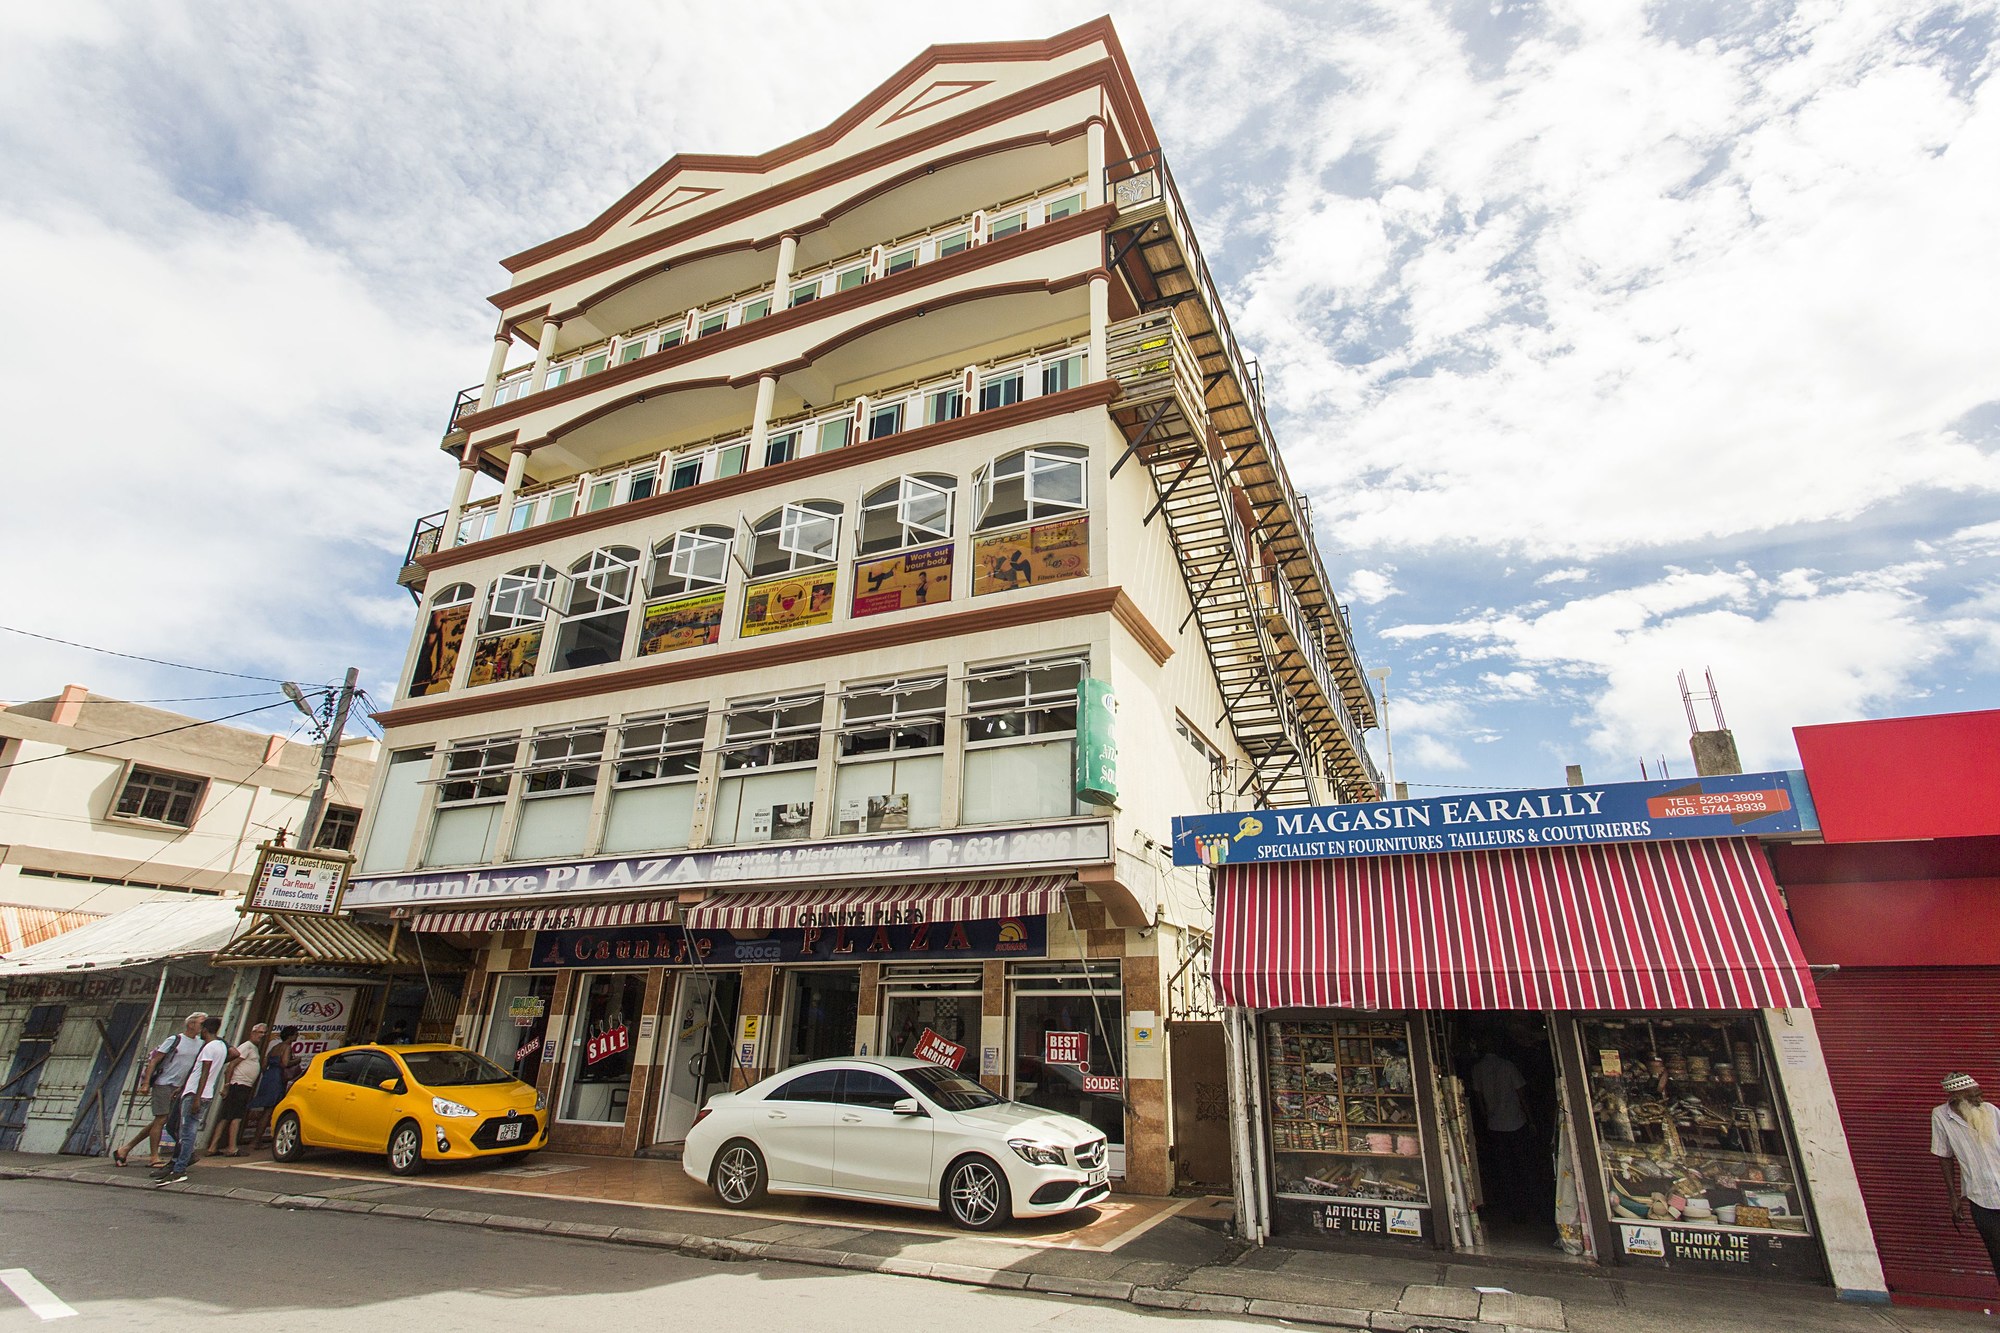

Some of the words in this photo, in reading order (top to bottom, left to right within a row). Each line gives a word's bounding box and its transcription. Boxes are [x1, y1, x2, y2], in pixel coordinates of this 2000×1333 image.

[982, 532, 1029, 547] AEROBIC
[910, 551, 932, 561] Work
[934, 548, 949, 557] out
[905, 562, 925, 571] your
[926, 557, 948, 567] body
[1667, 796, 1696, 807] TEL:
[1699, 792, 1764, 804] 5290-3909
[1275, 805, 1434, 836] MAGASIN
[1440, 791, 1605, 825] EARALLY
[1665, 805, 1699, 817] MOB:
[1701, 802, 1767, 815] 5744-8939
[963, 835, 1006, 863] 631
[1011, 831, 1071, 861] 2696
[1257, 838, 1326, 859] SPECIALIST
[1328, 839, 1346, 855] EN
[1348, 834, 1443, 855] FOURNITURES
[1447, 828, 1525, 848] TAILLEURS
[1528, 829, 1539, 843] &
[1542, 820, 1652, 843] COUTURIERES
[267, 853, 290, 864] Motel
[290, 856, 297, 865] &
[298, 857, 319, 869] Guest
[320, 861, 343, 872] House
[714, 853, 778, 868] Importer
[780, 850, 793, 863] &
[795, 845, 880, 862] Distributor
[882, 841, 903, 856] of
[780, 862, 820, 878] TILES
[840, 856, 921, 875] GRANITES
[282, 878, 294, 888] Car
[294, 880, 316, 890] Rental
[369, 873, 538, 901] Caunhye
[541, 856, 705, 891] PLAZA
[272, 887, 296, 898] Fitness
[297, 891, 319, 900] Centre
[876, 908, 924, 924] PLAZA
[574, 932, 713, 963] Caunhye
[801, 922, 972, 955] PLAZA
[316, 1024, 346, 1032] SQUARE
[291, 1041, 329, 1054] OTEL
[516, 1039, 539, 1060] SOLDES
[589, 1031, 626, 1059] SALE
[931, 1036, 957, 1056] NEW
[1049, 1035, 1078, 1048] BEST
[920, 1045, 956, 1069] ARRIVAL
[1050, 1048, 1078, 1061] DEAL
[1325, 1204, 1381, 1219] ARTICLES
[1326, 1218, 1340, 1229] DE
[1351, 1219, 1381, 1232] LUXE
[1670, 1231, 1722, 1247] BIJOUX
[1729, 1233, 1749, 1249] DE
[1675, 1245, 1750, 1263] FANTAISIE
